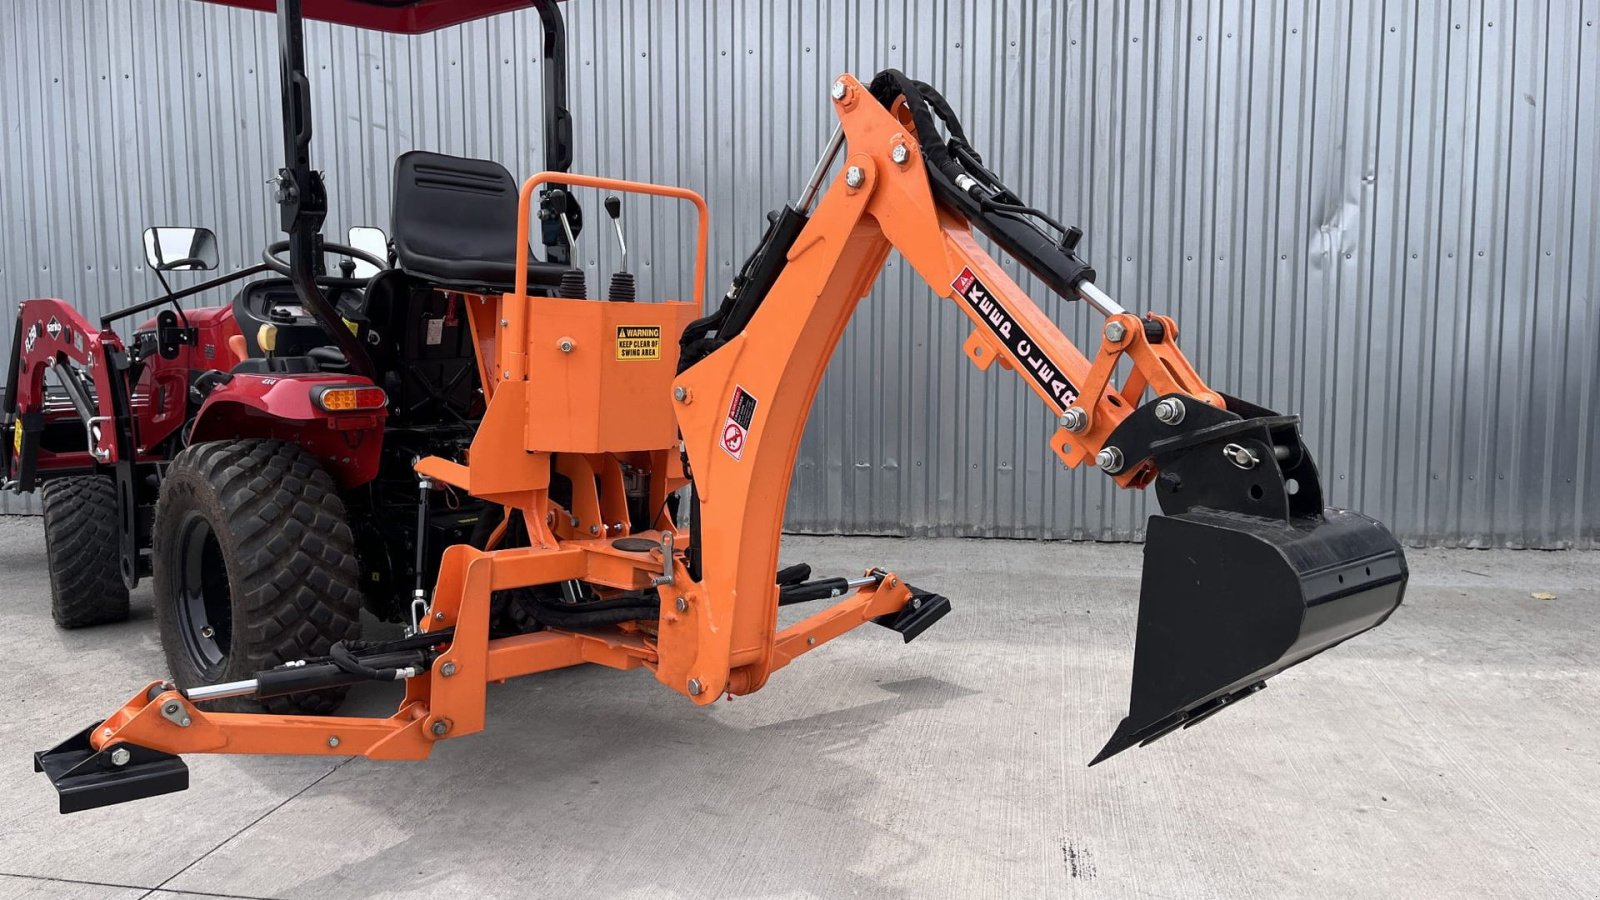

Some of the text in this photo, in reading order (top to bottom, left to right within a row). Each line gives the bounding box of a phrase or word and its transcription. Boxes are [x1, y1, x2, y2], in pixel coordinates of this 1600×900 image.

[627, 329, 659, 337] WARNING
[634, 340, 650, 348] CLEAR
[968, 284, 1077, 407] KEEP CLEAR
